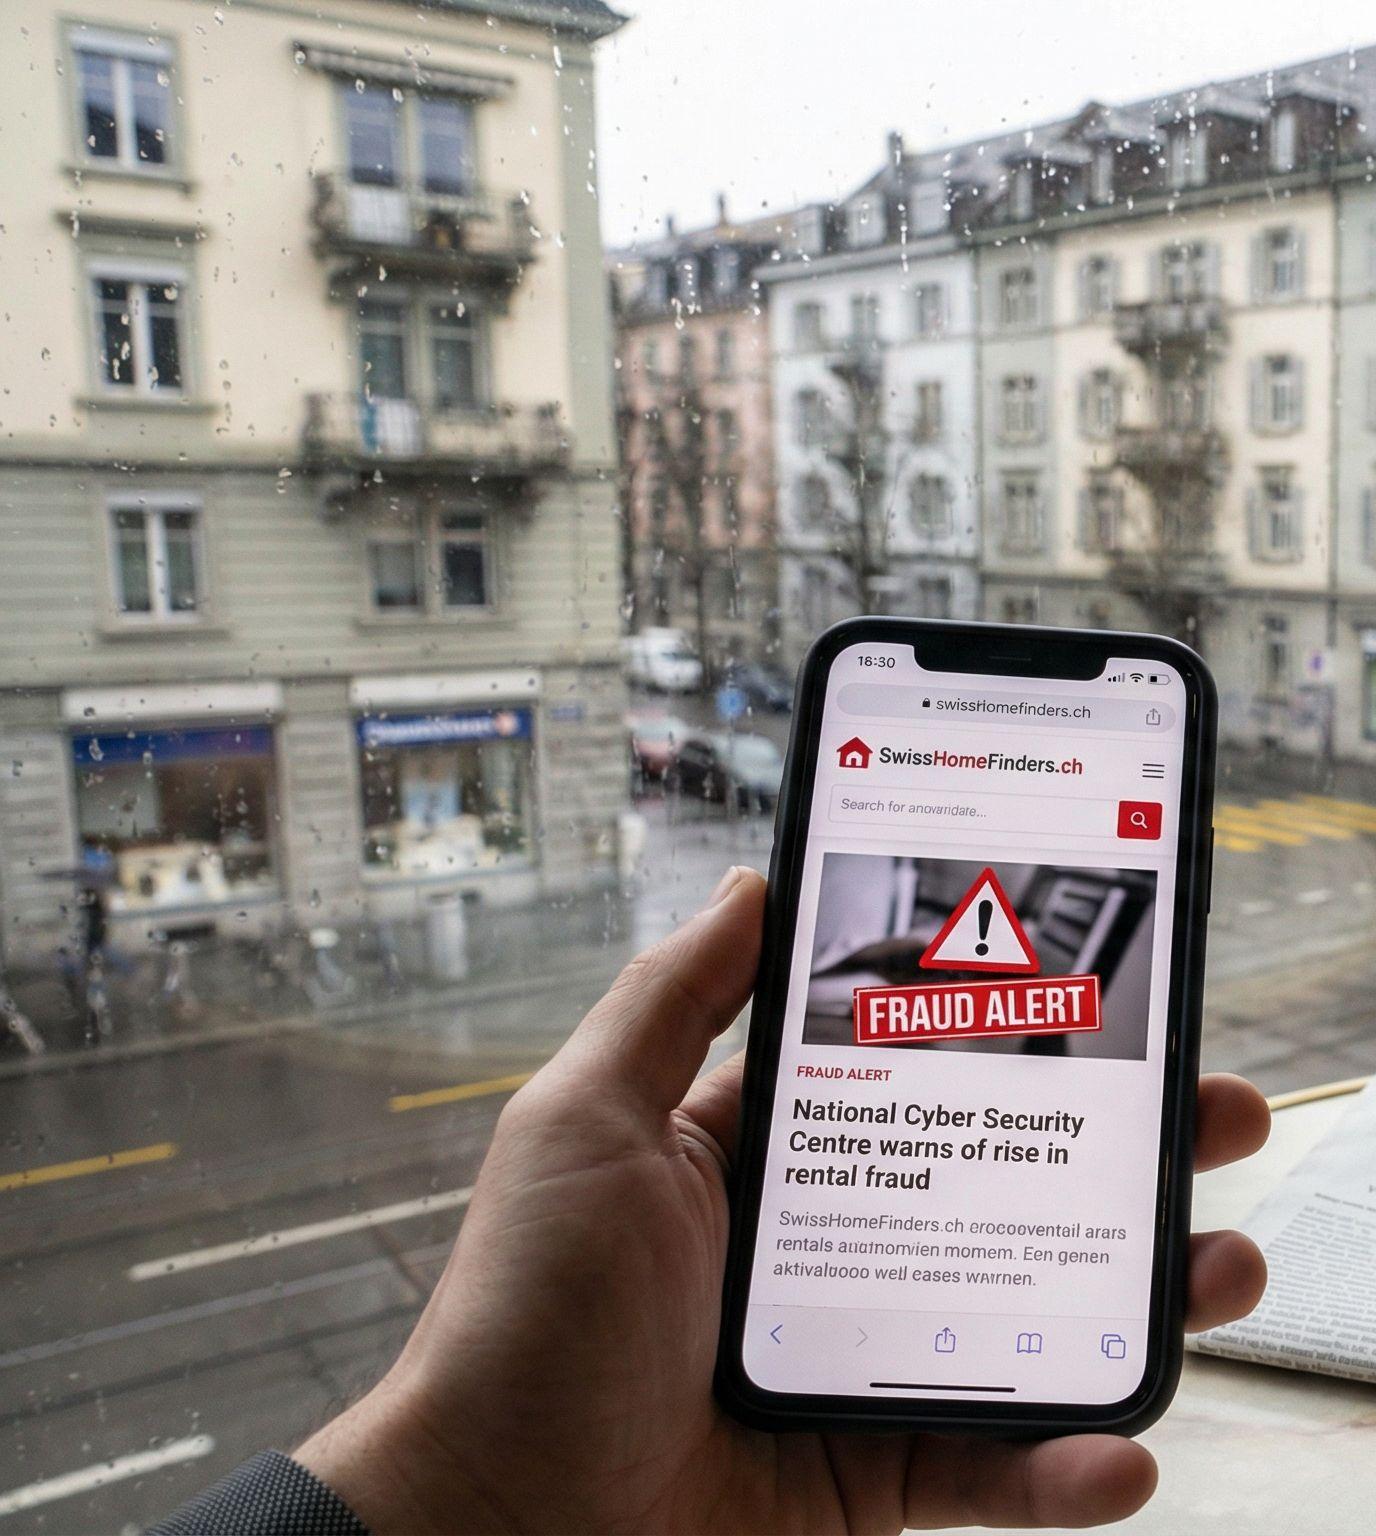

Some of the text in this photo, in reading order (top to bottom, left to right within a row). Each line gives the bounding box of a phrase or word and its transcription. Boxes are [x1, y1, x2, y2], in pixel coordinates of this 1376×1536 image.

[879, 747, 1082, 775] SwissHomeFinders.ch
[841, 798, 884, 812] Search
[888, 801, 906, 812] for
[868, 985, 1087, 1034] FRAUD ALERT
[797, 1066, 892, 1081] FRAUD ALERT
[793, 1099, 1084, 1138] National Cyber Security
[790, 1131, 1068, 1164] Centre warns of rise in
[785, 1165, 930, 1190] rental fraud
[779, 1211, 963, 1233] SwissHomeFinders.ch
[777, 1237, 833, 1252] rentals
[945, 1246, 1016, 1260] momem.
[1024, 1246, 1052, 1261] Een
[1058, 1251, 1109, 1266] genen
